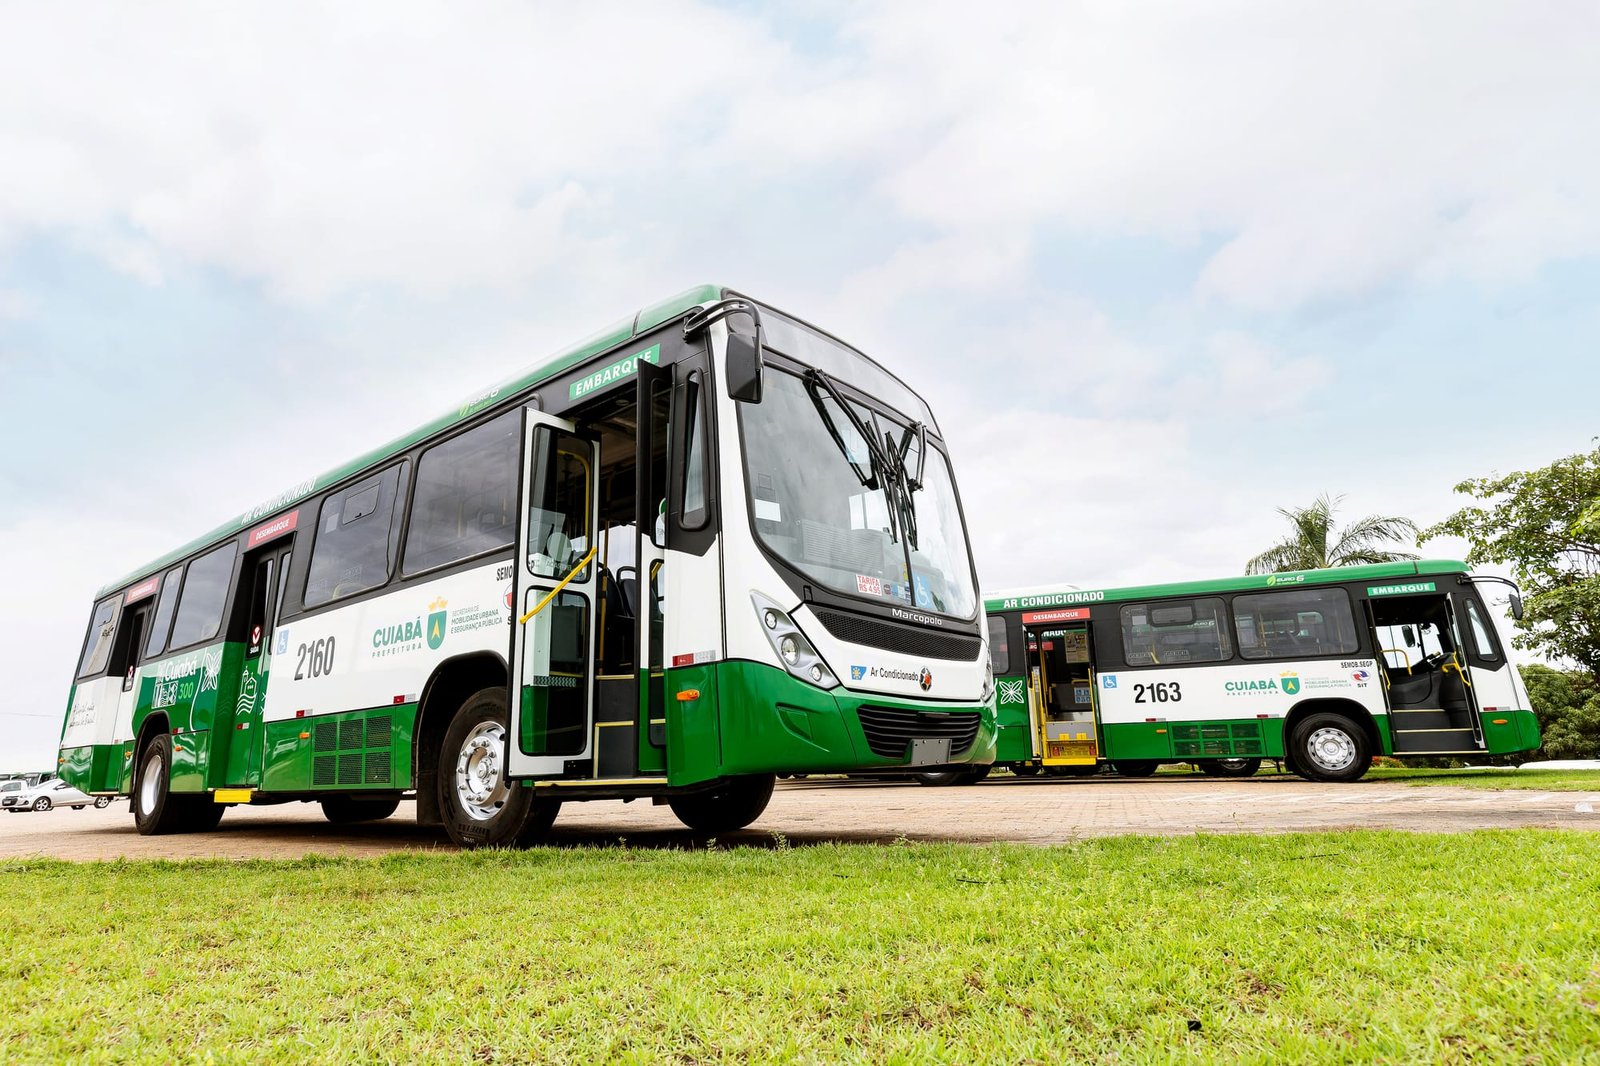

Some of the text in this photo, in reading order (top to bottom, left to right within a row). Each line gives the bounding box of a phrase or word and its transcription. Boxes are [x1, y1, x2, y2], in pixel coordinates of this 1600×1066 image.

[575, 350, 652, 396] EMBARQUE
[496, 565, 514, 581] SEMO
[857, 575, 880, 588] TARIFA
[1372, 584, 1430, 595] EMBARQUE
[1004, 591, 1105, 609] AR CONDICIONADO
[451, 608, 499, 625] MOBILIDADE URBANA
[454, 621, 482, 633] SEGURANÇA
[482, 616, 503, 627] PÚBLICA
[891, 607, 943, 626] Marcopolo
[1033, 612, 1079, 621] DESEMBARQUE
[373, 615, 423, 648] CUIABÁ
[294, 636, 336, 681] 2160
[372, 641, 422, 659] PREFEITURA
[870, 666, 919, 682] Ar Condicionado
[178, 682, 195, 699] 300
[1133, 682, 1183, 704] 2163
[1225, 678, 1278, 691] CUIABÁ
